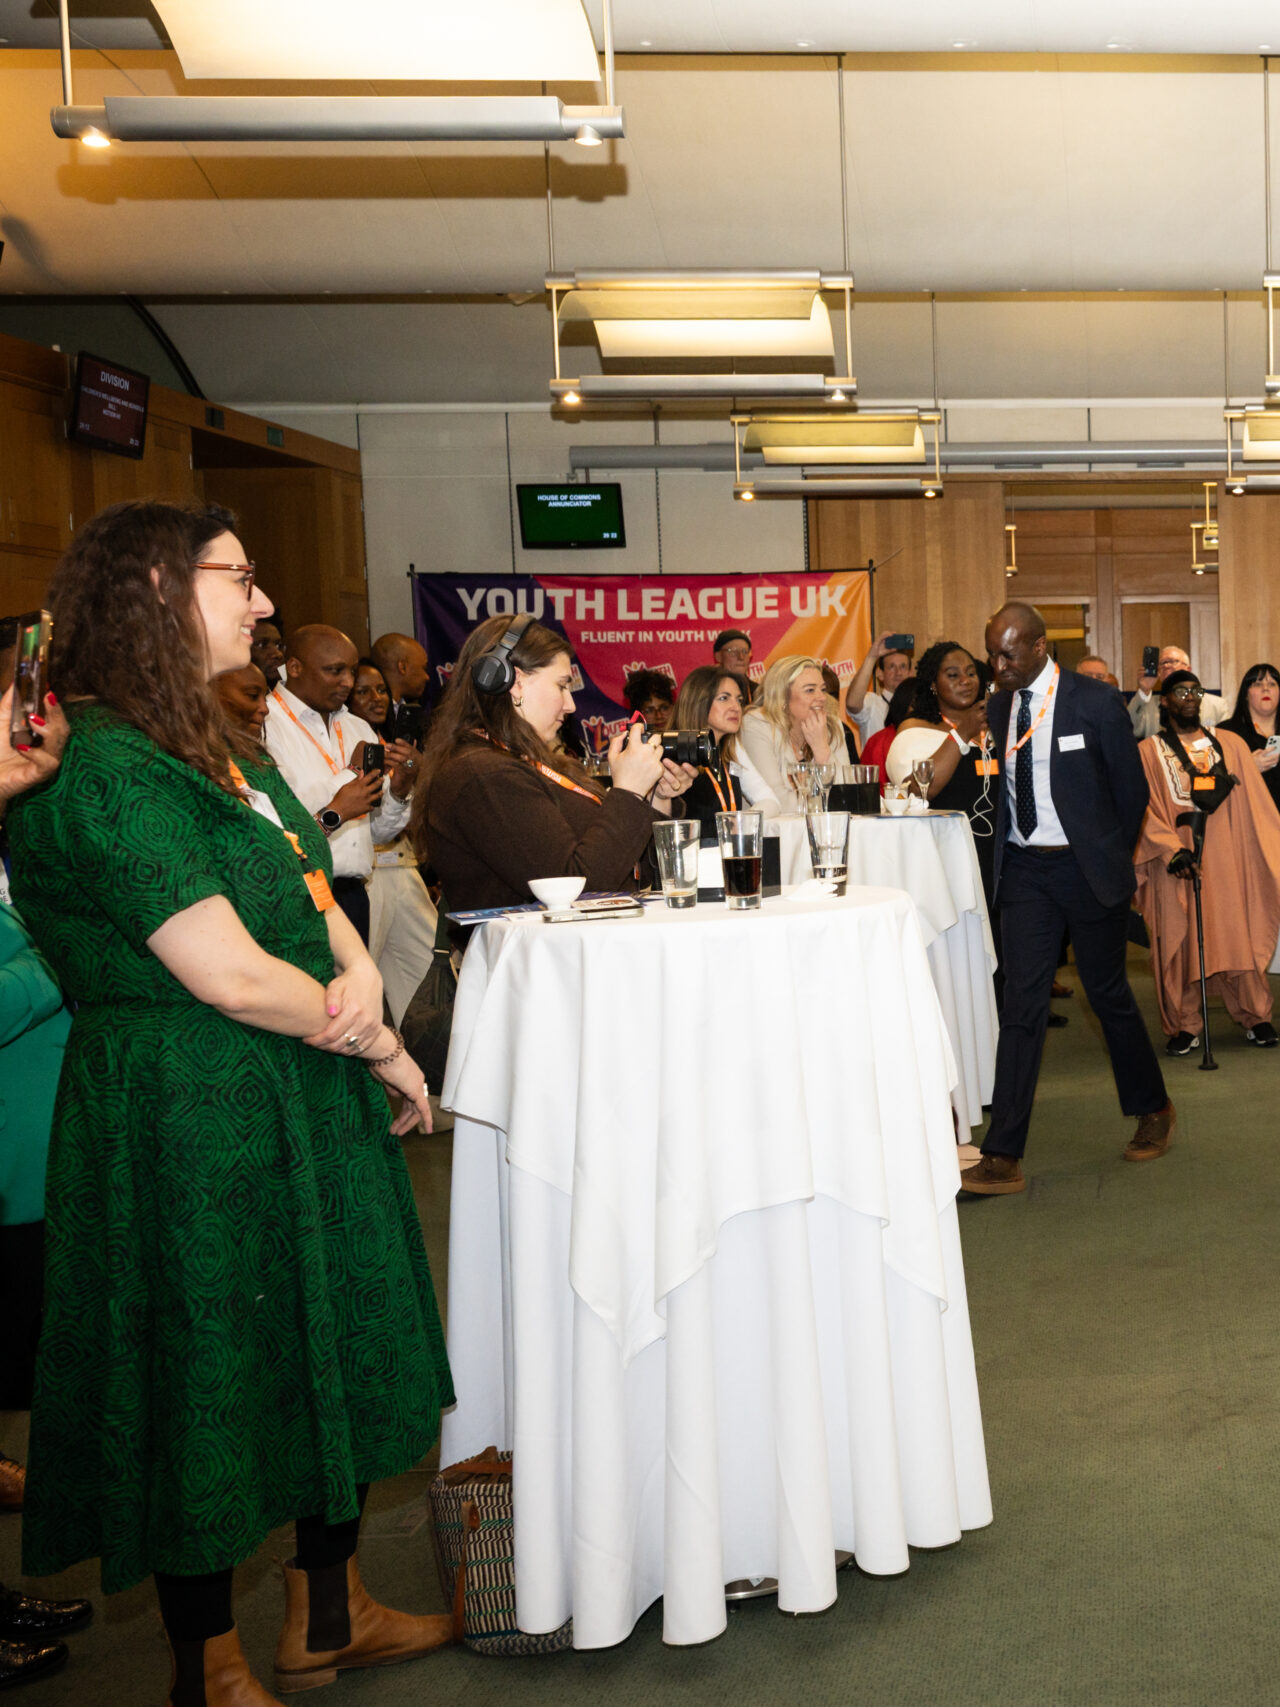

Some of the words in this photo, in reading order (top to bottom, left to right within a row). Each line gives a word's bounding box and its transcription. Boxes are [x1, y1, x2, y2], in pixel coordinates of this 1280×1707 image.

[101, 371, 130, 391] DIVISION
[456, 587, 605, 620] YOUTH
[617, 587, 779, 620] LEAGUE
[790, 585, 847, 617] UK
[581, 631, 635, 643] FLUENT
[638, 631, 651, 642] IN
[656, 630, 704, 642] YOUTH
